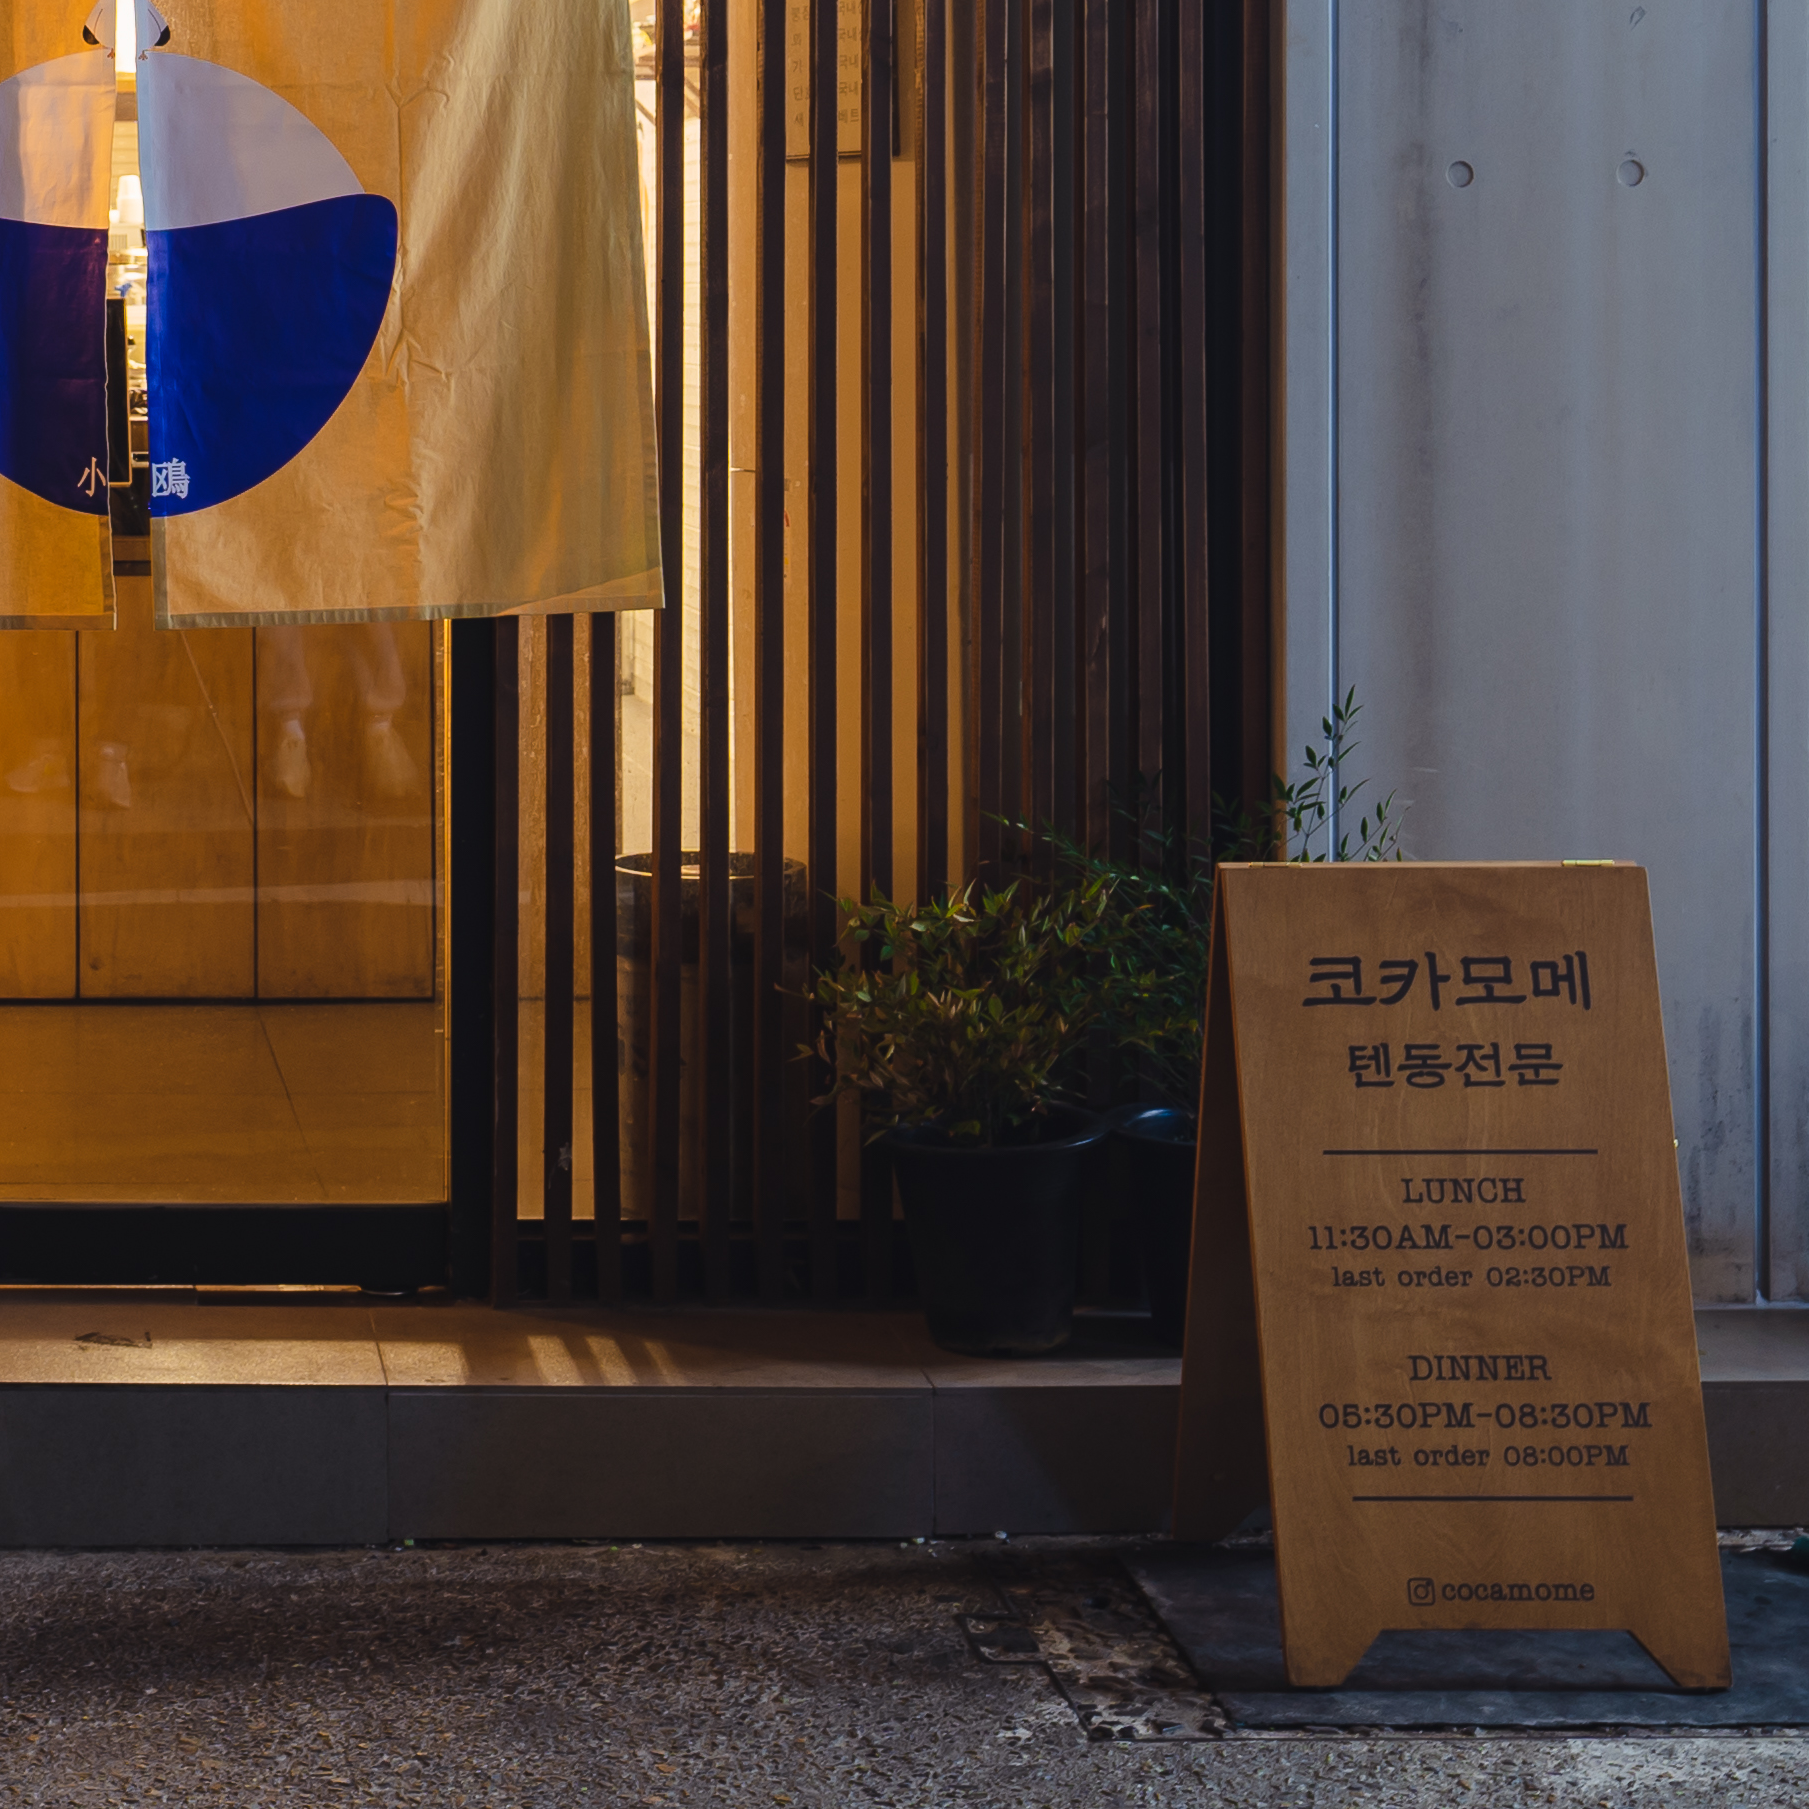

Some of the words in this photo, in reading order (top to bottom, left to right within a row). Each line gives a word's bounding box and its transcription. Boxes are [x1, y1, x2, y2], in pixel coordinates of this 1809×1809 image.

[1302, 950, 1592, 1012] 코카모메
[1348, 1042, 1564, 1090] 텐동전문
[1401, 1177, 1528, 1205] LUNCH
[1308, 1223, 1631, 1252] 11:30AM-03:00PM
[1331, 1266, 1387, 1289] last
[1398, 1266, 1475, 1289] order
[1486, 1266, 1613, 1289] 02:30PM
[1407, 1355, 1554, 1383] DINNER
[1319, 1402, 1654, 1430] 05:30PM-08:30PM
[1347, 1445, 1403, 1468] last
[1414, 1445, 1491, 1468] order
[1504, 1445, 1632, 1468] 08:00PM
[1442, 1583, 1596, 1603] cocamome
